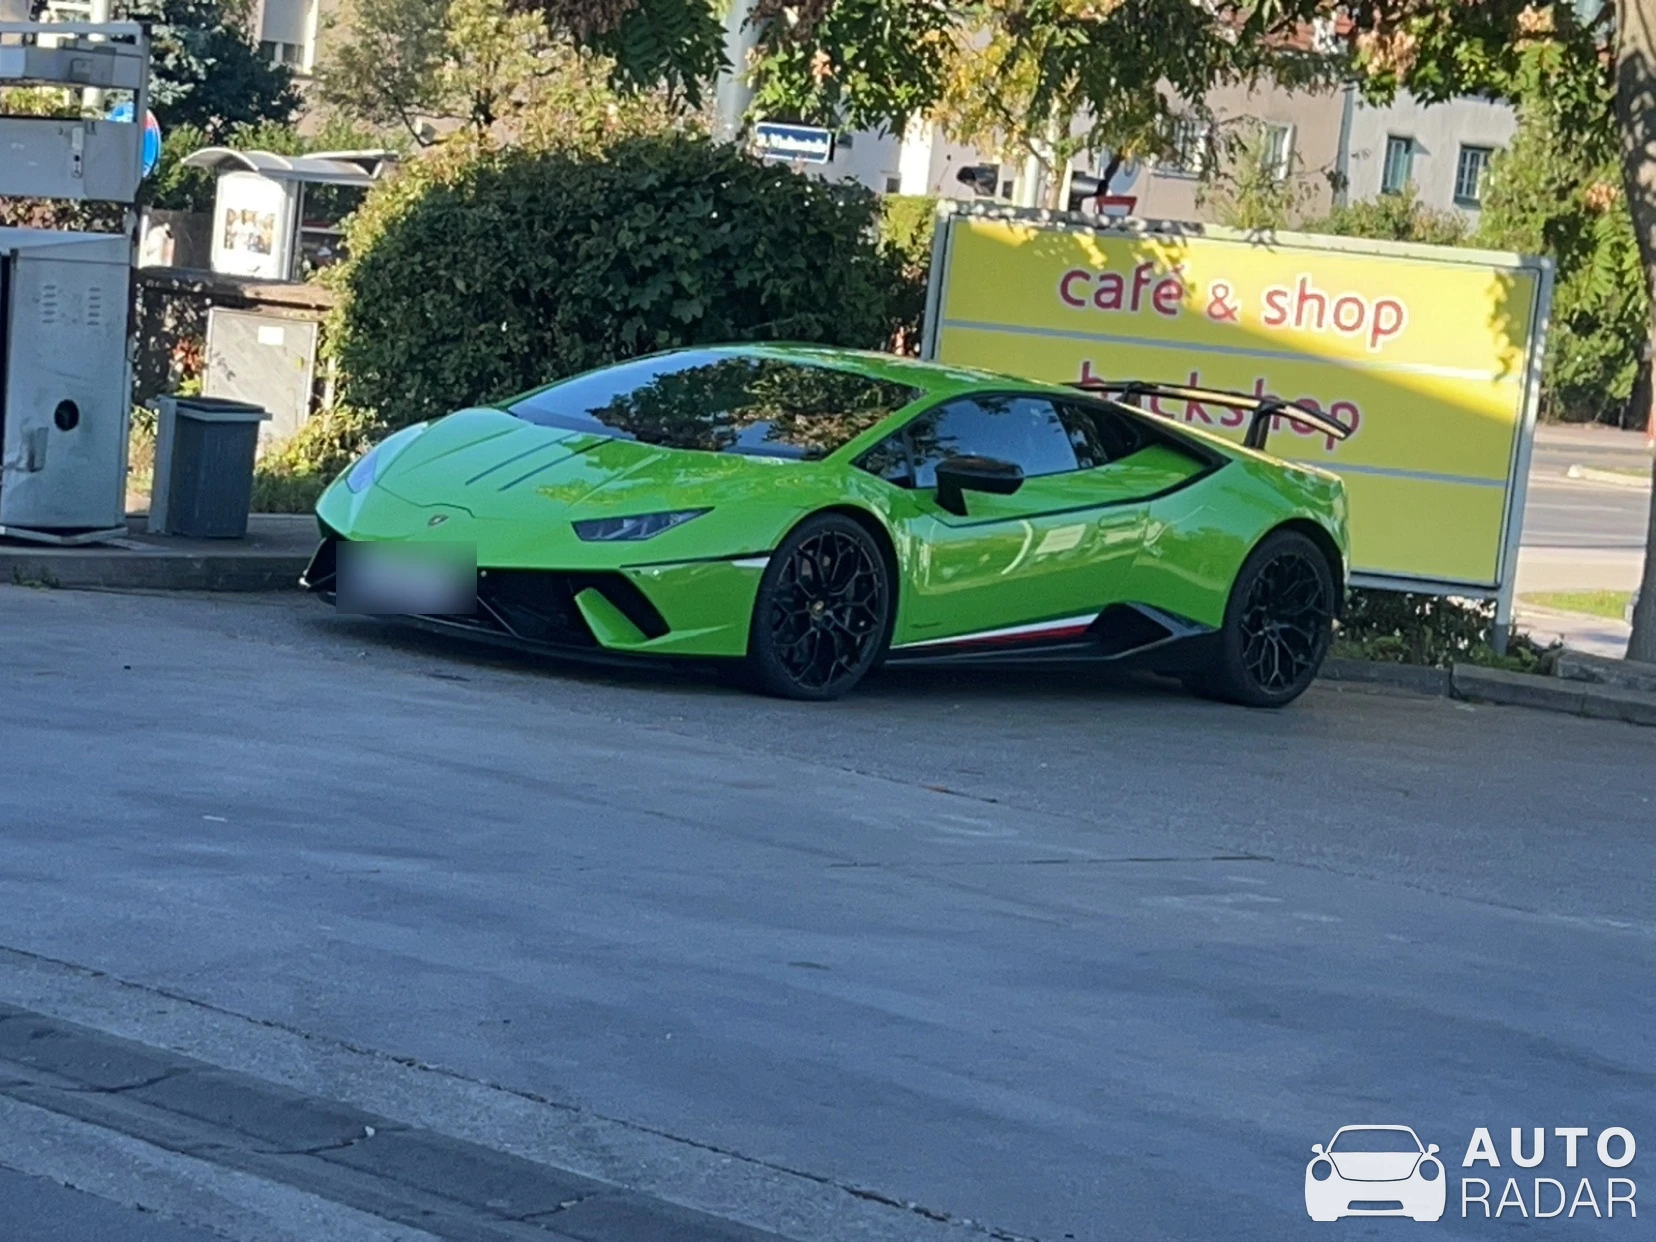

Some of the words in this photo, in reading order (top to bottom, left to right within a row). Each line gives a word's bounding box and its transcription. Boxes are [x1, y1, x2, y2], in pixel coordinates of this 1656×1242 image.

[1060, 261, 1185, 315] café
[1206, 283, 1238, 321] &
[1263, 276, 1404, 349] shop
[1079, 360, 1360, 451] bckshop
